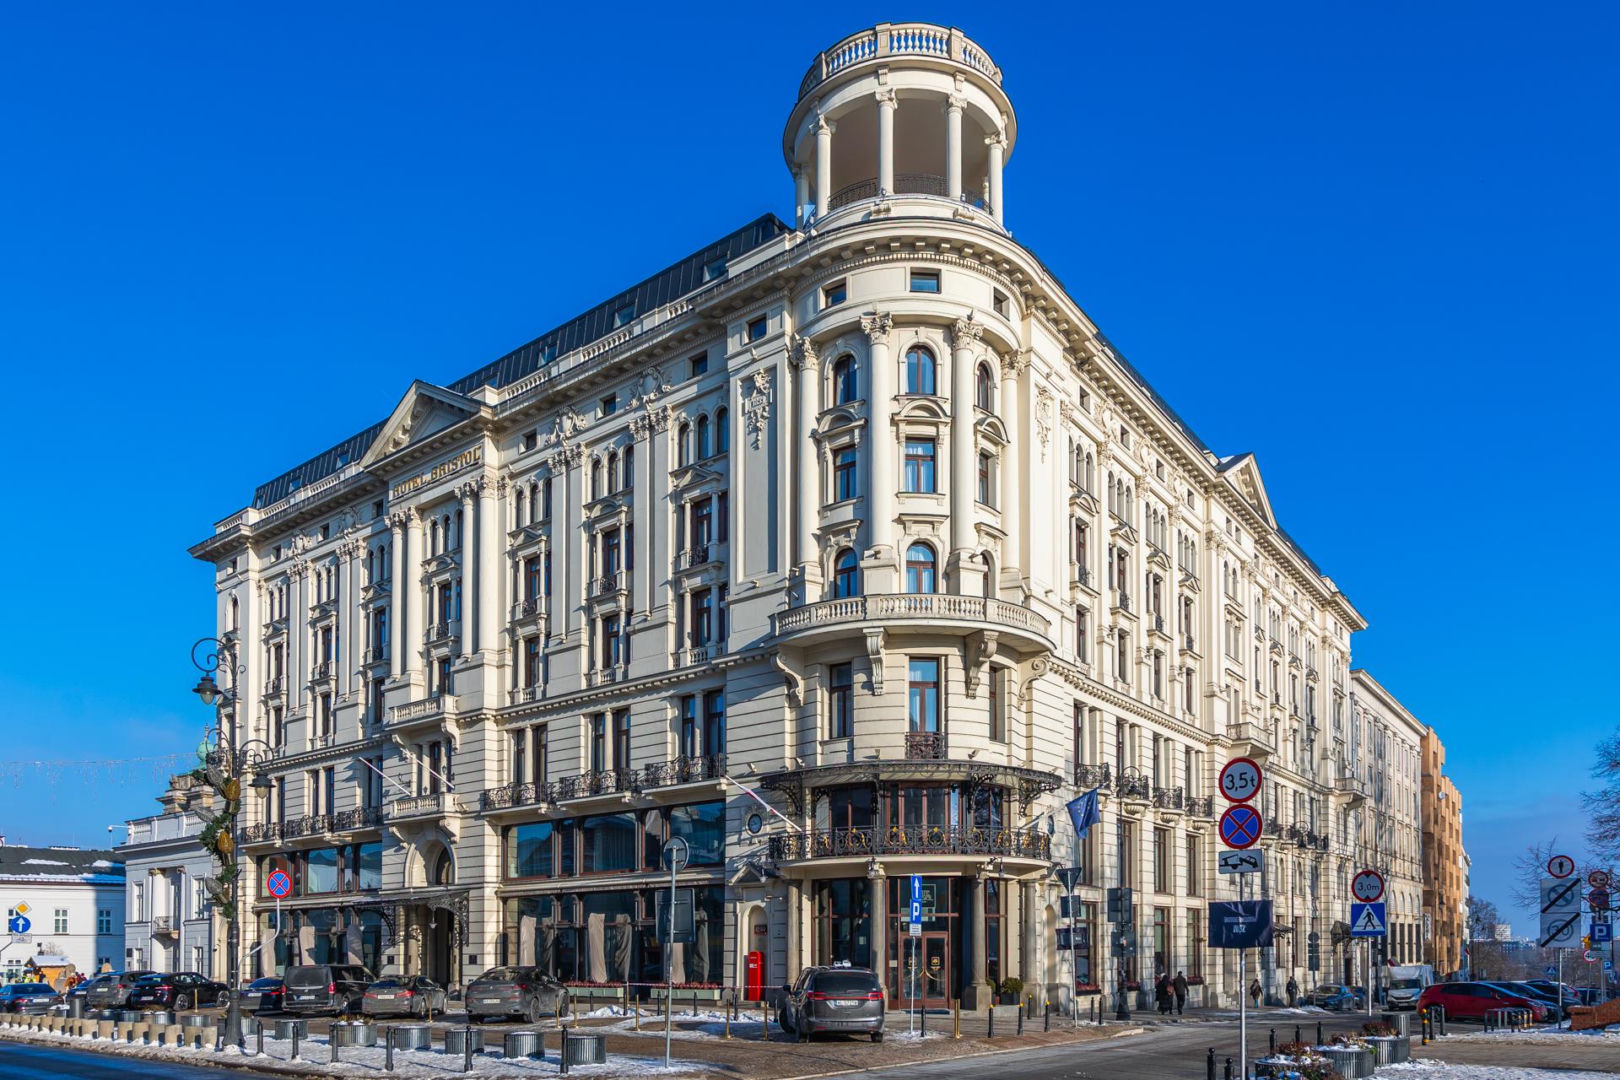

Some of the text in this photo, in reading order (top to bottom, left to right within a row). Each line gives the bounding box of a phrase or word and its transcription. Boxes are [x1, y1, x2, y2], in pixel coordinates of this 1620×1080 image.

[393, 446, 481, 497] HOTEL BRISTOL
[912, 902, 920, 920] P
[1594, 926, 1607, 940] P
[1604, 961, 1611, 969] P
